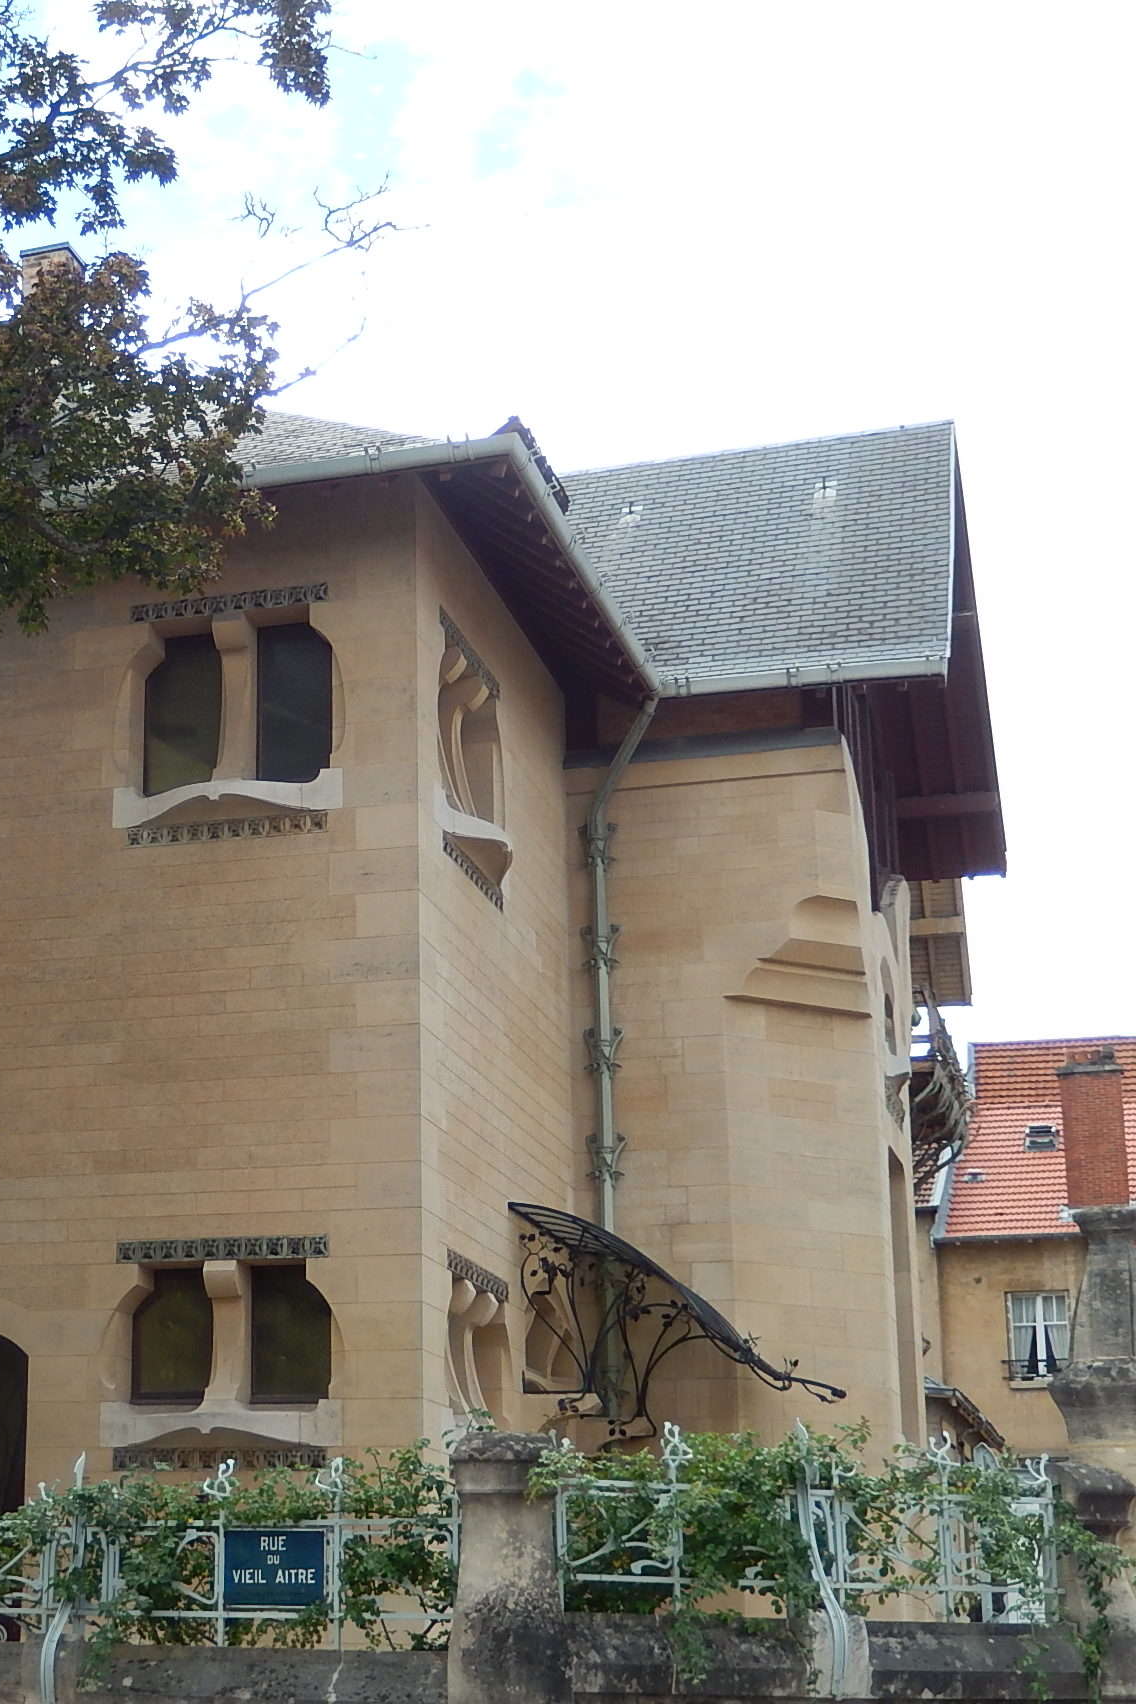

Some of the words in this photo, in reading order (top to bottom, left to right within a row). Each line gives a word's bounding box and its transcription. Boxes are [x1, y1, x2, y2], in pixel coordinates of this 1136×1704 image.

[260, 1536, 287, 1551] RUE
[267, 1554, 280, 1565] DU
[232, 1568, 267, 1584] VIEIL
[275, 1568, 316, 1584] AITRE
